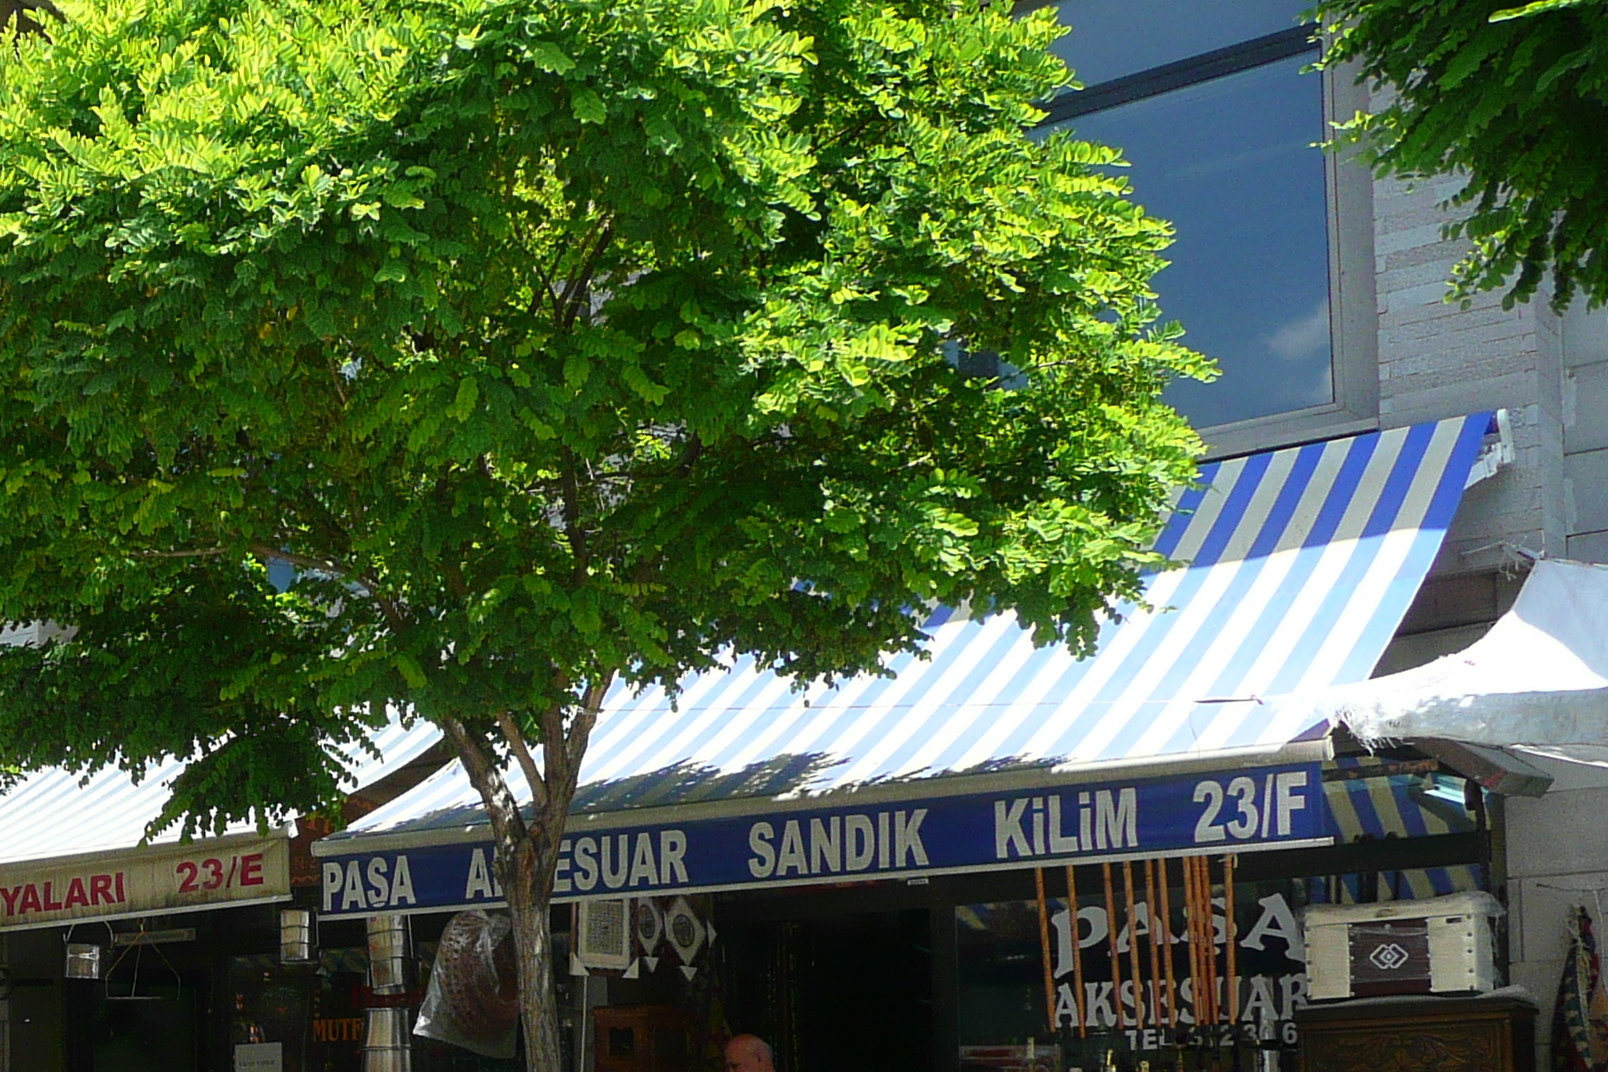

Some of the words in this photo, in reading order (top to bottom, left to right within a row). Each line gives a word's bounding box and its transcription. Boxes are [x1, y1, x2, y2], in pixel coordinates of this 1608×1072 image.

[747, 808, 930, 879] SANDIK
[1192, 771, 1307, 843] 23/F
[176, 853, 264, 894] 23/E
